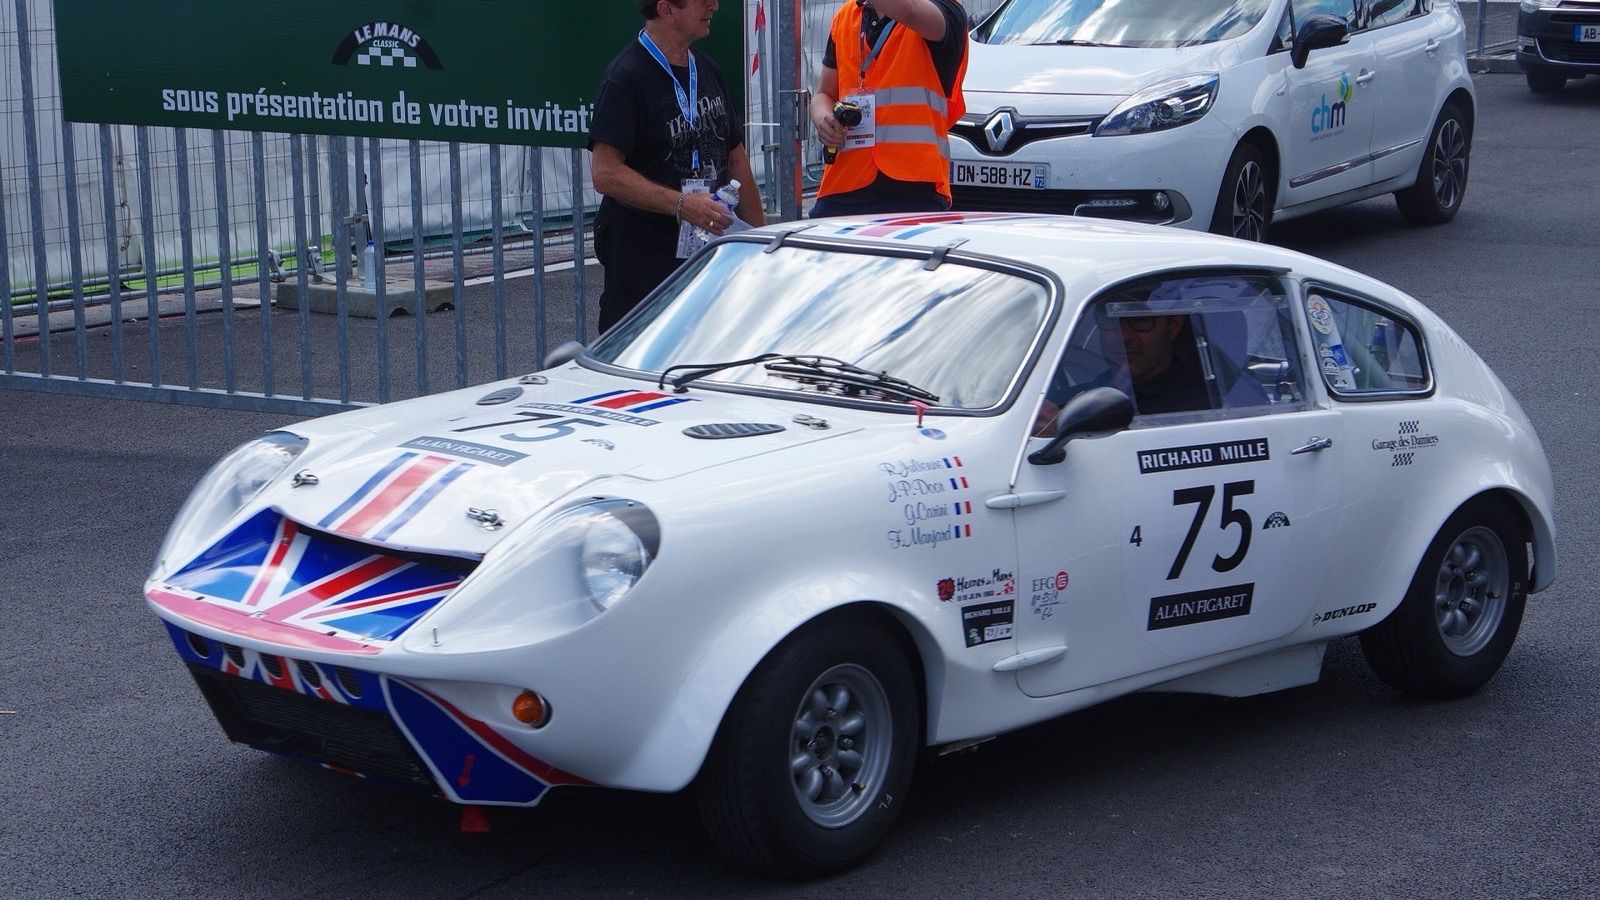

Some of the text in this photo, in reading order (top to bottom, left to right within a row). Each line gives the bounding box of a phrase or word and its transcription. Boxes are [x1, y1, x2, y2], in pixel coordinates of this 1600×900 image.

[354, 22, 421, 48] LE MANS
[373, 40, 399, 48] CLASSIC
[162, 88, 219, 113] sous
[226, 87, 384, 122] présentation
[391, 90, 421, 125] de
[428, 99, 499, 129] votre
[1311, 93, 1346, 134] chm
[957, 165, 1032, 186] DN-588-HZ
[1036, 177, 1045, 188] 72
[452, 411, 610, 442] 75
[598, 411, 654, 427] MILLE
[413, 439, 517, 462] ALAIN FIGARET
[1372, 438, 1397, 452] Garage
[1398, 436, 1410, 447] des
[1141, 442, 1267, 470] RICHARD MILLE
[1130, 525, 1142, 547] 4
[1166, 479, 1255, 581] 75
[1032, 576, 1055, 593] EFG
[992, 606, 1012, 615] MILLE
[1155, 593, 1248, 621] ALAIN FIGARET
[1321, 602, 1377, 621] DUNLOP
